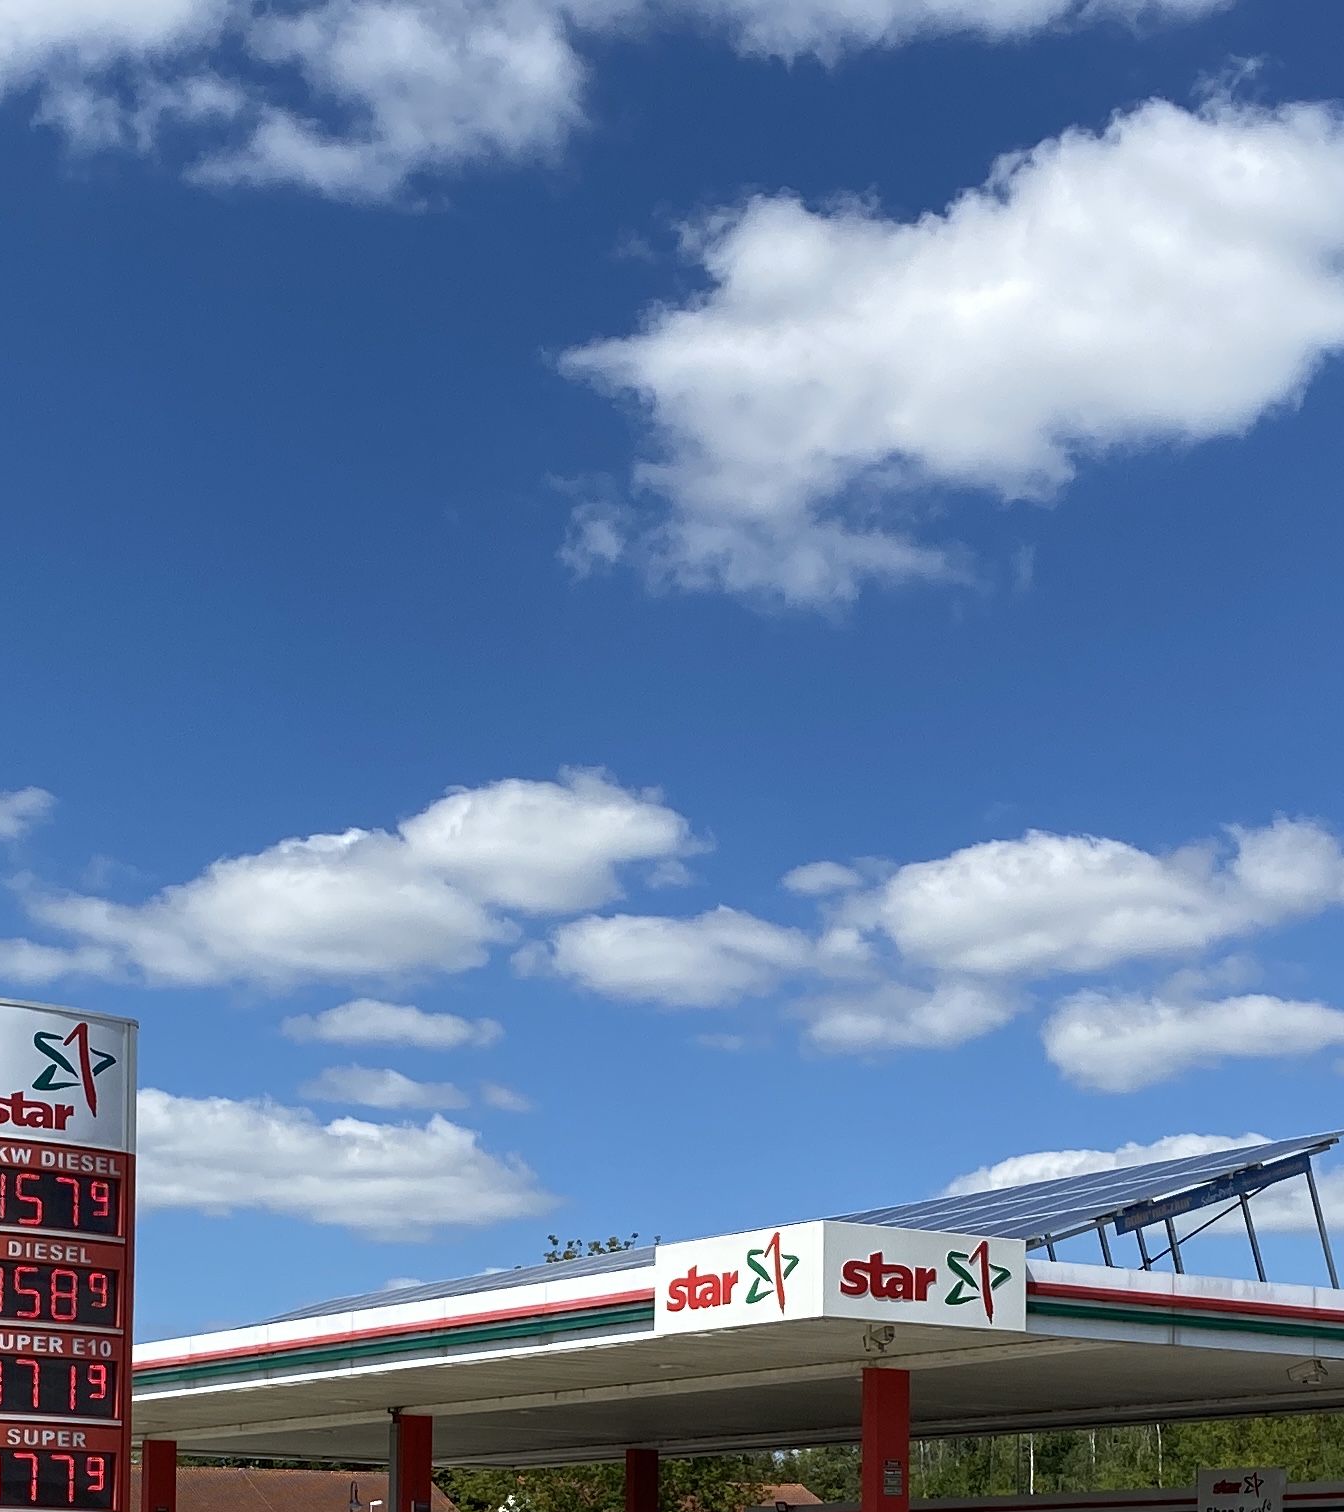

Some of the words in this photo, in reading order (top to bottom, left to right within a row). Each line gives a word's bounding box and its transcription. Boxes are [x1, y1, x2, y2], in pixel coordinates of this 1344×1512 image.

[41, 1151, 121, 1176] DIESEL
[8, 1241, 92, 1264] DIESEL
[667, 1264, 739, 1312] star
[840, 1251, 937, 1302] star
[72, 1338, 112, 1358] E10
[7, 1428, 86, 1448] SUPER
